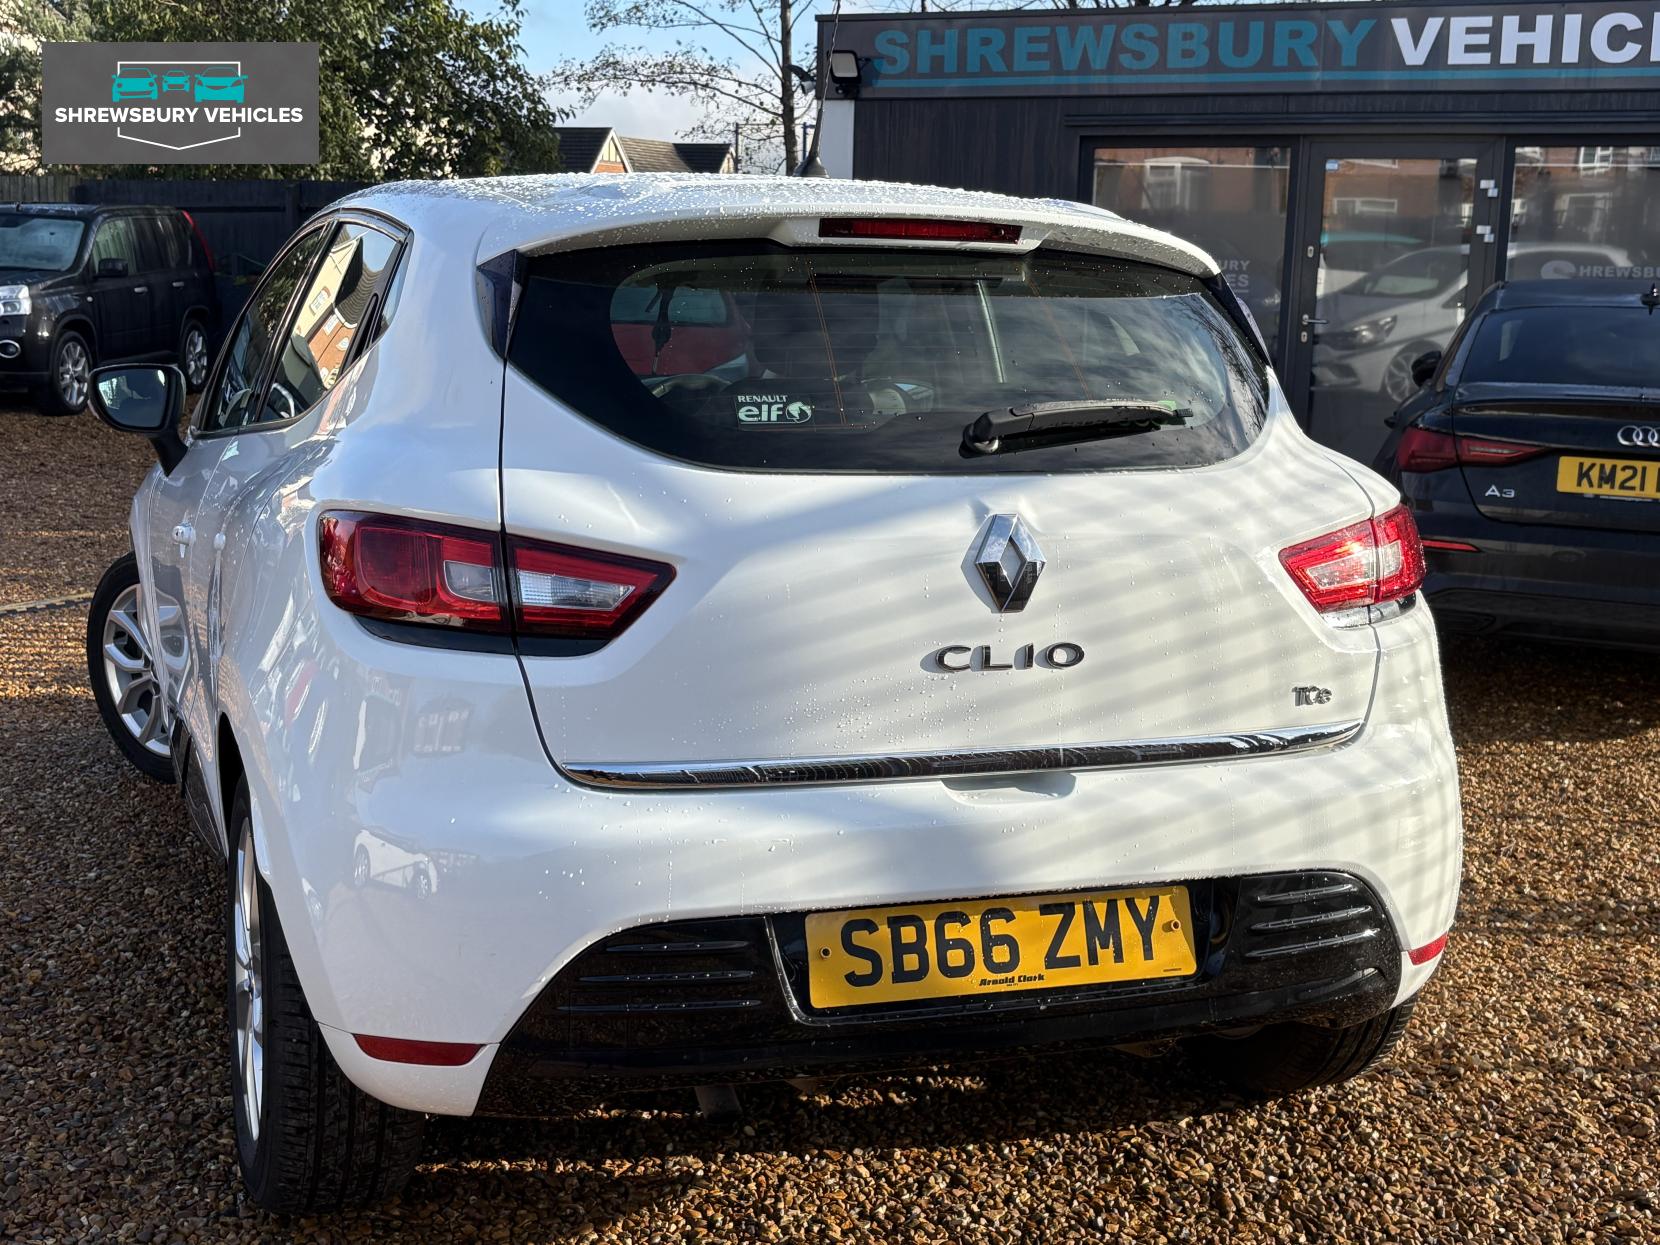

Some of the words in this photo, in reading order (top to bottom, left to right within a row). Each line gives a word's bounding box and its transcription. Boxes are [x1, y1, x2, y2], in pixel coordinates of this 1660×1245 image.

[873, 18, 1378, 75] SHREWSBURY
[737, 395, 788, 403] RENAULT
[738, 403, 783, 422] elf
[1576, 461, 1647, 492] KM21
[1485, 484, 1515, 498] A3
[935, 642, 1085, 672] CLIO
[840, 907, 1021, 988] SB66
[1038, 895, 1161, 970] ZMY
[979, 976, 1015, 986] Arnold
[1018, 973, 1045, 983] Clark
